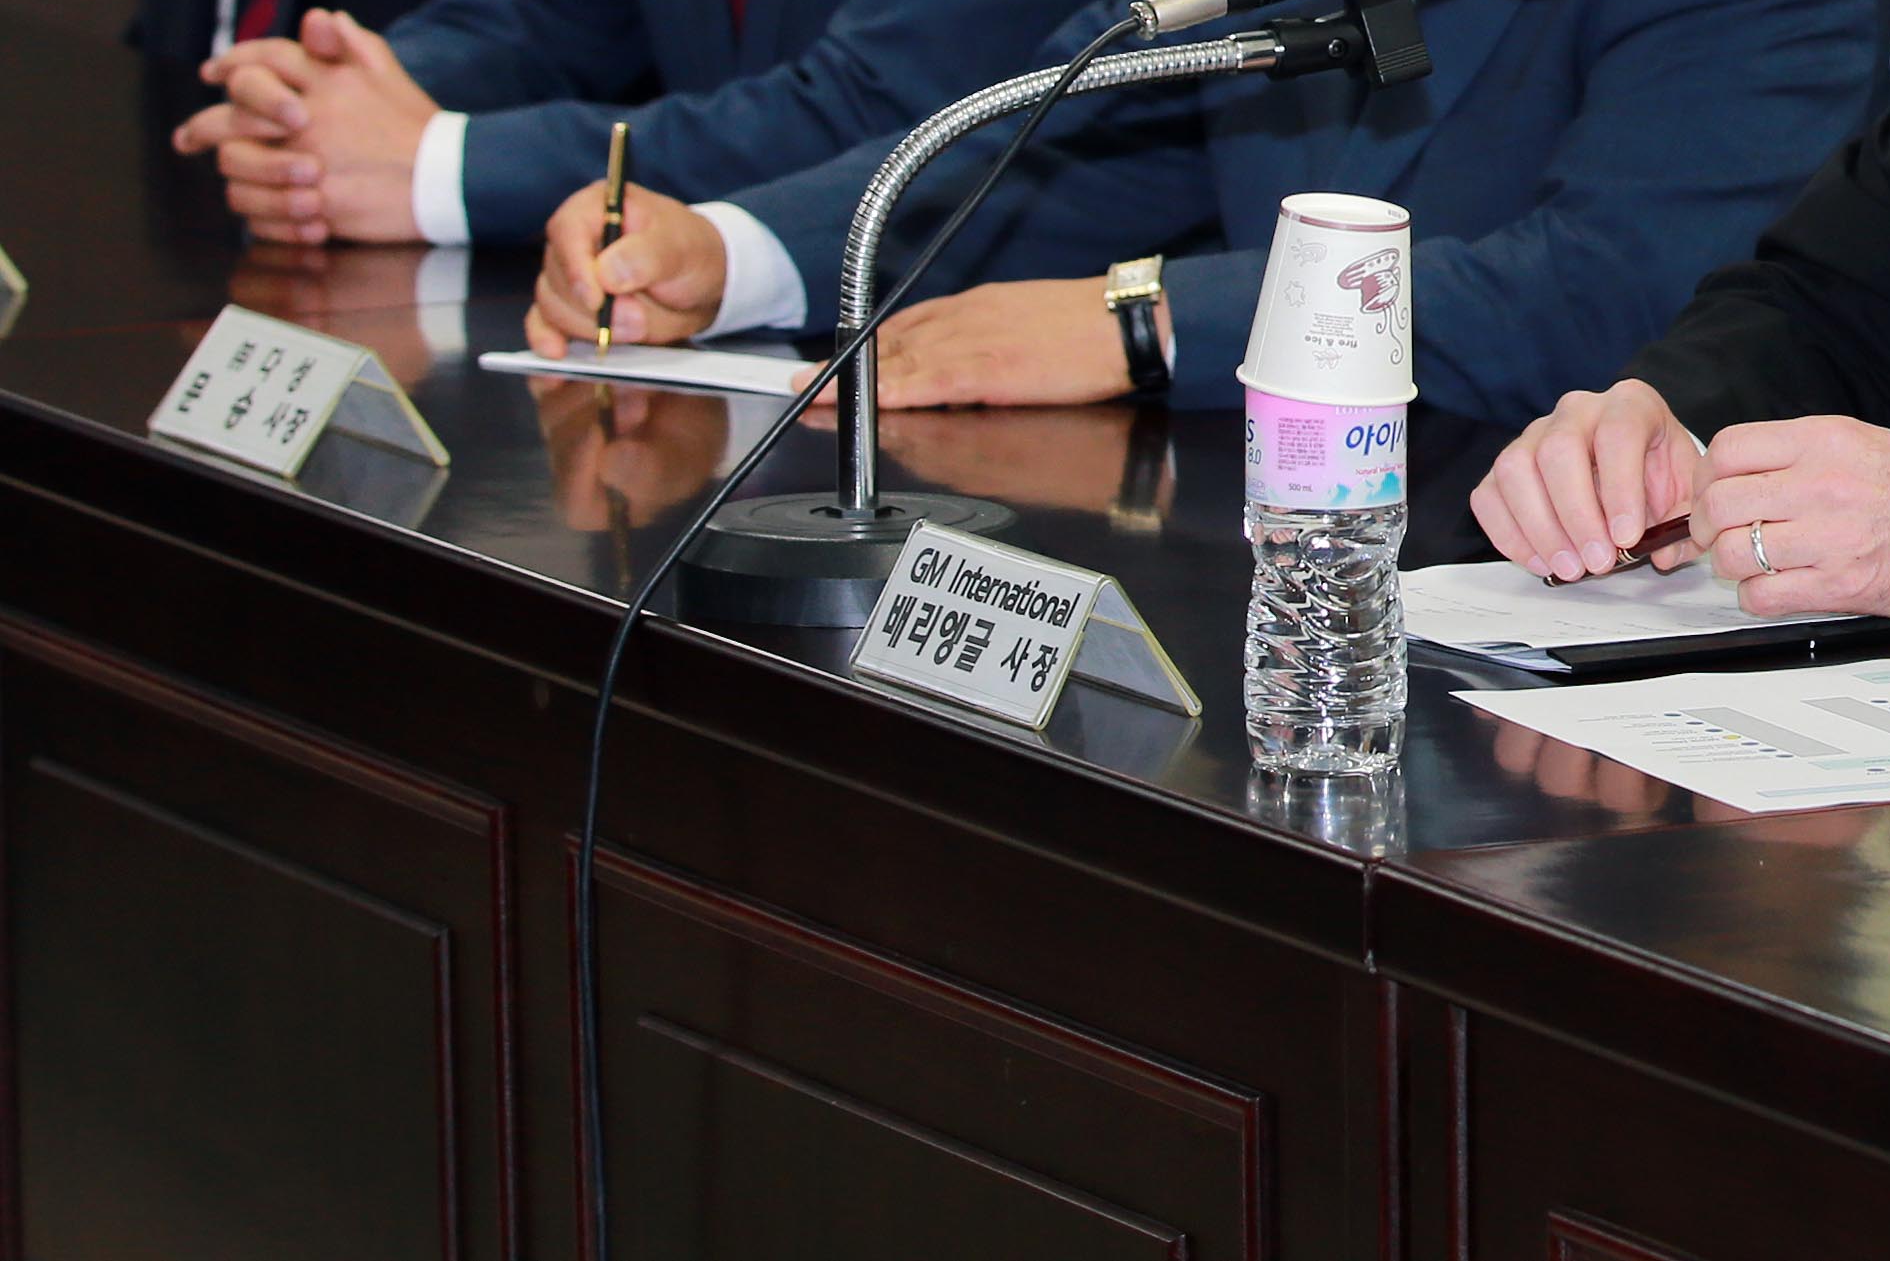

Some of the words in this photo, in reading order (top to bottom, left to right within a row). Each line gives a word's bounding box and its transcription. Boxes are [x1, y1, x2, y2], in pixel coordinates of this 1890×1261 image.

[910, 548, 953, 588] GM
[947, 559, 1081, 629] International
[1000, 637, 1058, 692] 사장
